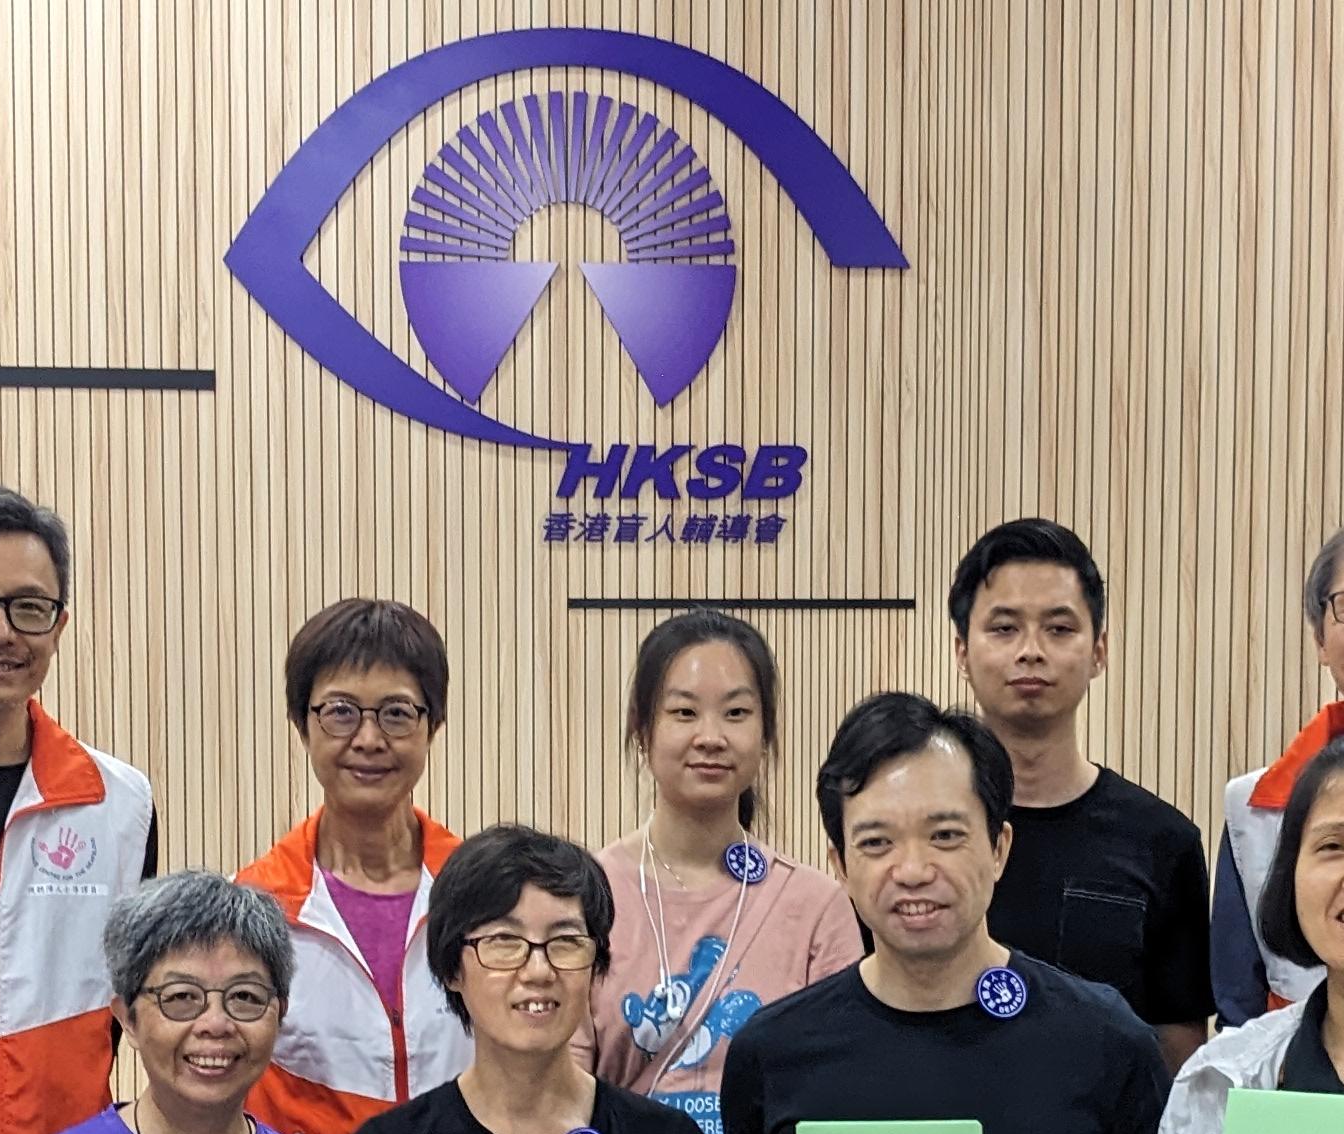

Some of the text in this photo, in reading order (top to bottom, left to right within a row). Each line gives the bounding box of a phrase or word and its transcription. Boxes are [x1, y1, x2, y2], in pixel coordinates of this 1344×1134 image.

[555, 444, 808, 499] HKSB
[542, 512, 788, 546] 香港盲人輔導會
